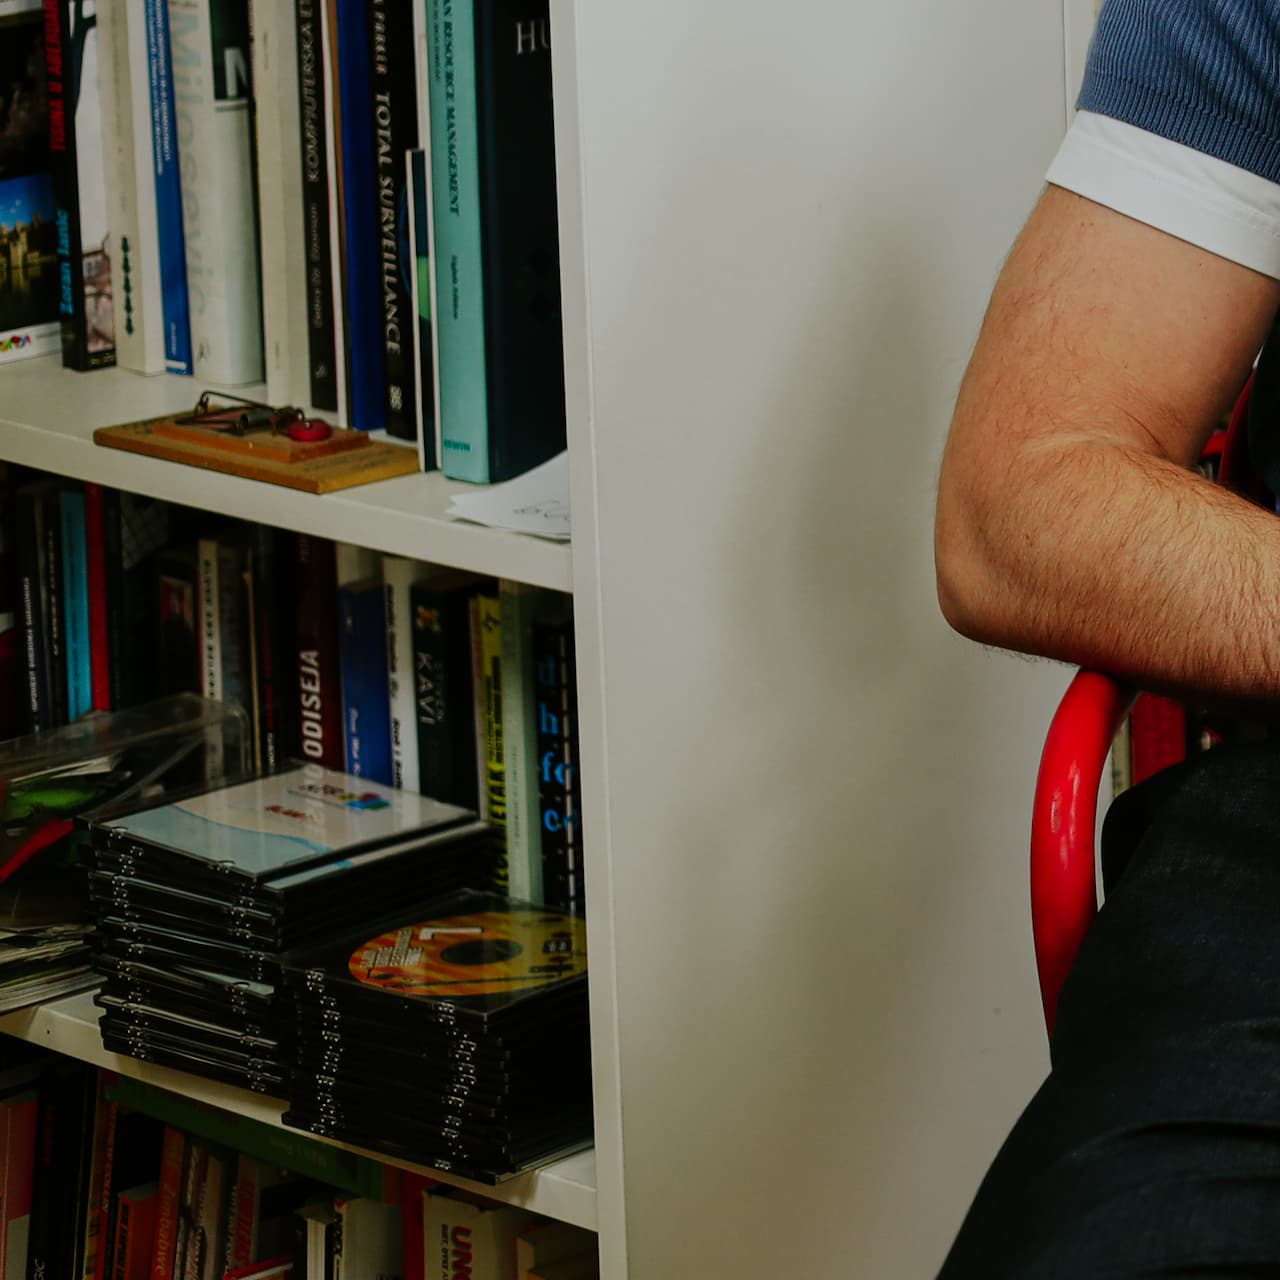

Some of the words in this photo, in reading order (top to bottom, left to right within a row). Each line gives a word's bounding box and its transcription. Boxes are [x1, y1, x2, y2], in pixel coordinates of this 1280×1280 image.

[372, 11, 388, 75] PARKER
[443, 21, 456, 101] RESOURCE
[374, 90, 392, 169] TOTAL
[445, 106, 460, 217] MANAGEMENT
[57, 261, 75, 315] Zoran
[377, 174, 401, 356] SURVEILLANCE
[298, 649, 324, 759] ODISEJA
[416, 651, 435, 726] KAVI
